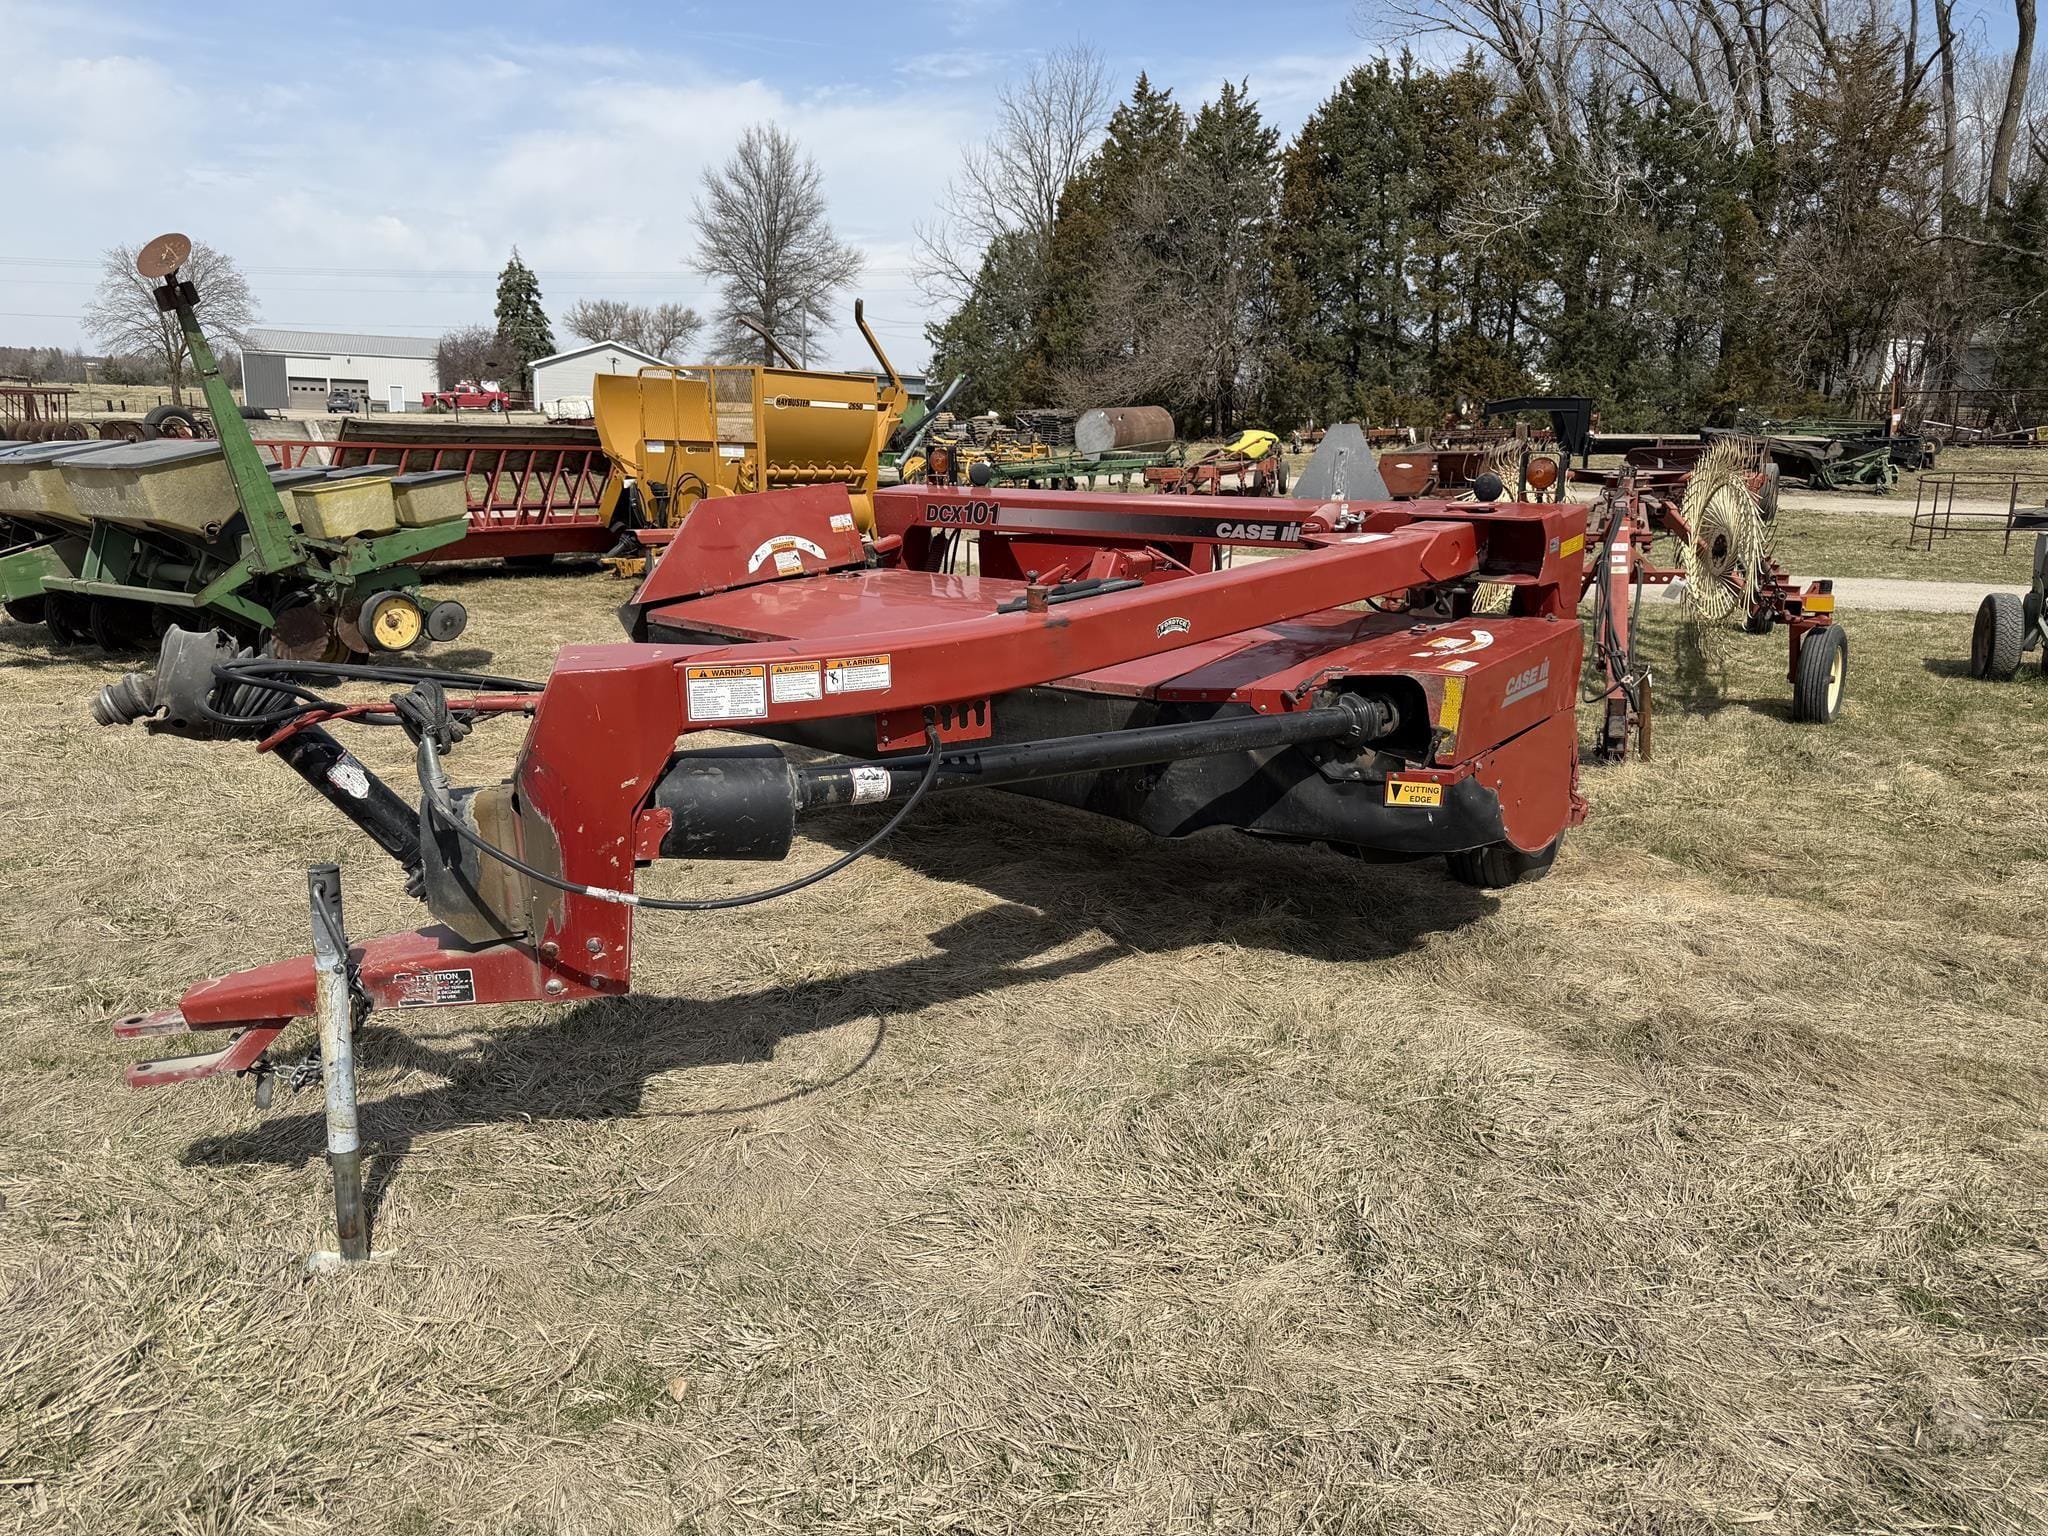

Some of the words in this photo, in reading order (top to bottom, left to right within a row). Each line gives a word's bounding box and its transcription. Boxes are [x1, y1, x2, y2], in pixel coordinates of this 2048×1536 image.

[775, 397, 811, 408] HAYBUSTER
[848, 402, 863, 411] 2650
[926, 501, 1000, 525] DCX101
[1216, 522, 1278, 541] CASE
[711, 668, 752, 677] WARNING
[784, 664, 815, 672] WARNING
[1506, 667, 1538, 695] CASE
[1404, 785, 1439, 795] CUTTING
[1409, 795, 1432, 804] EDGE
